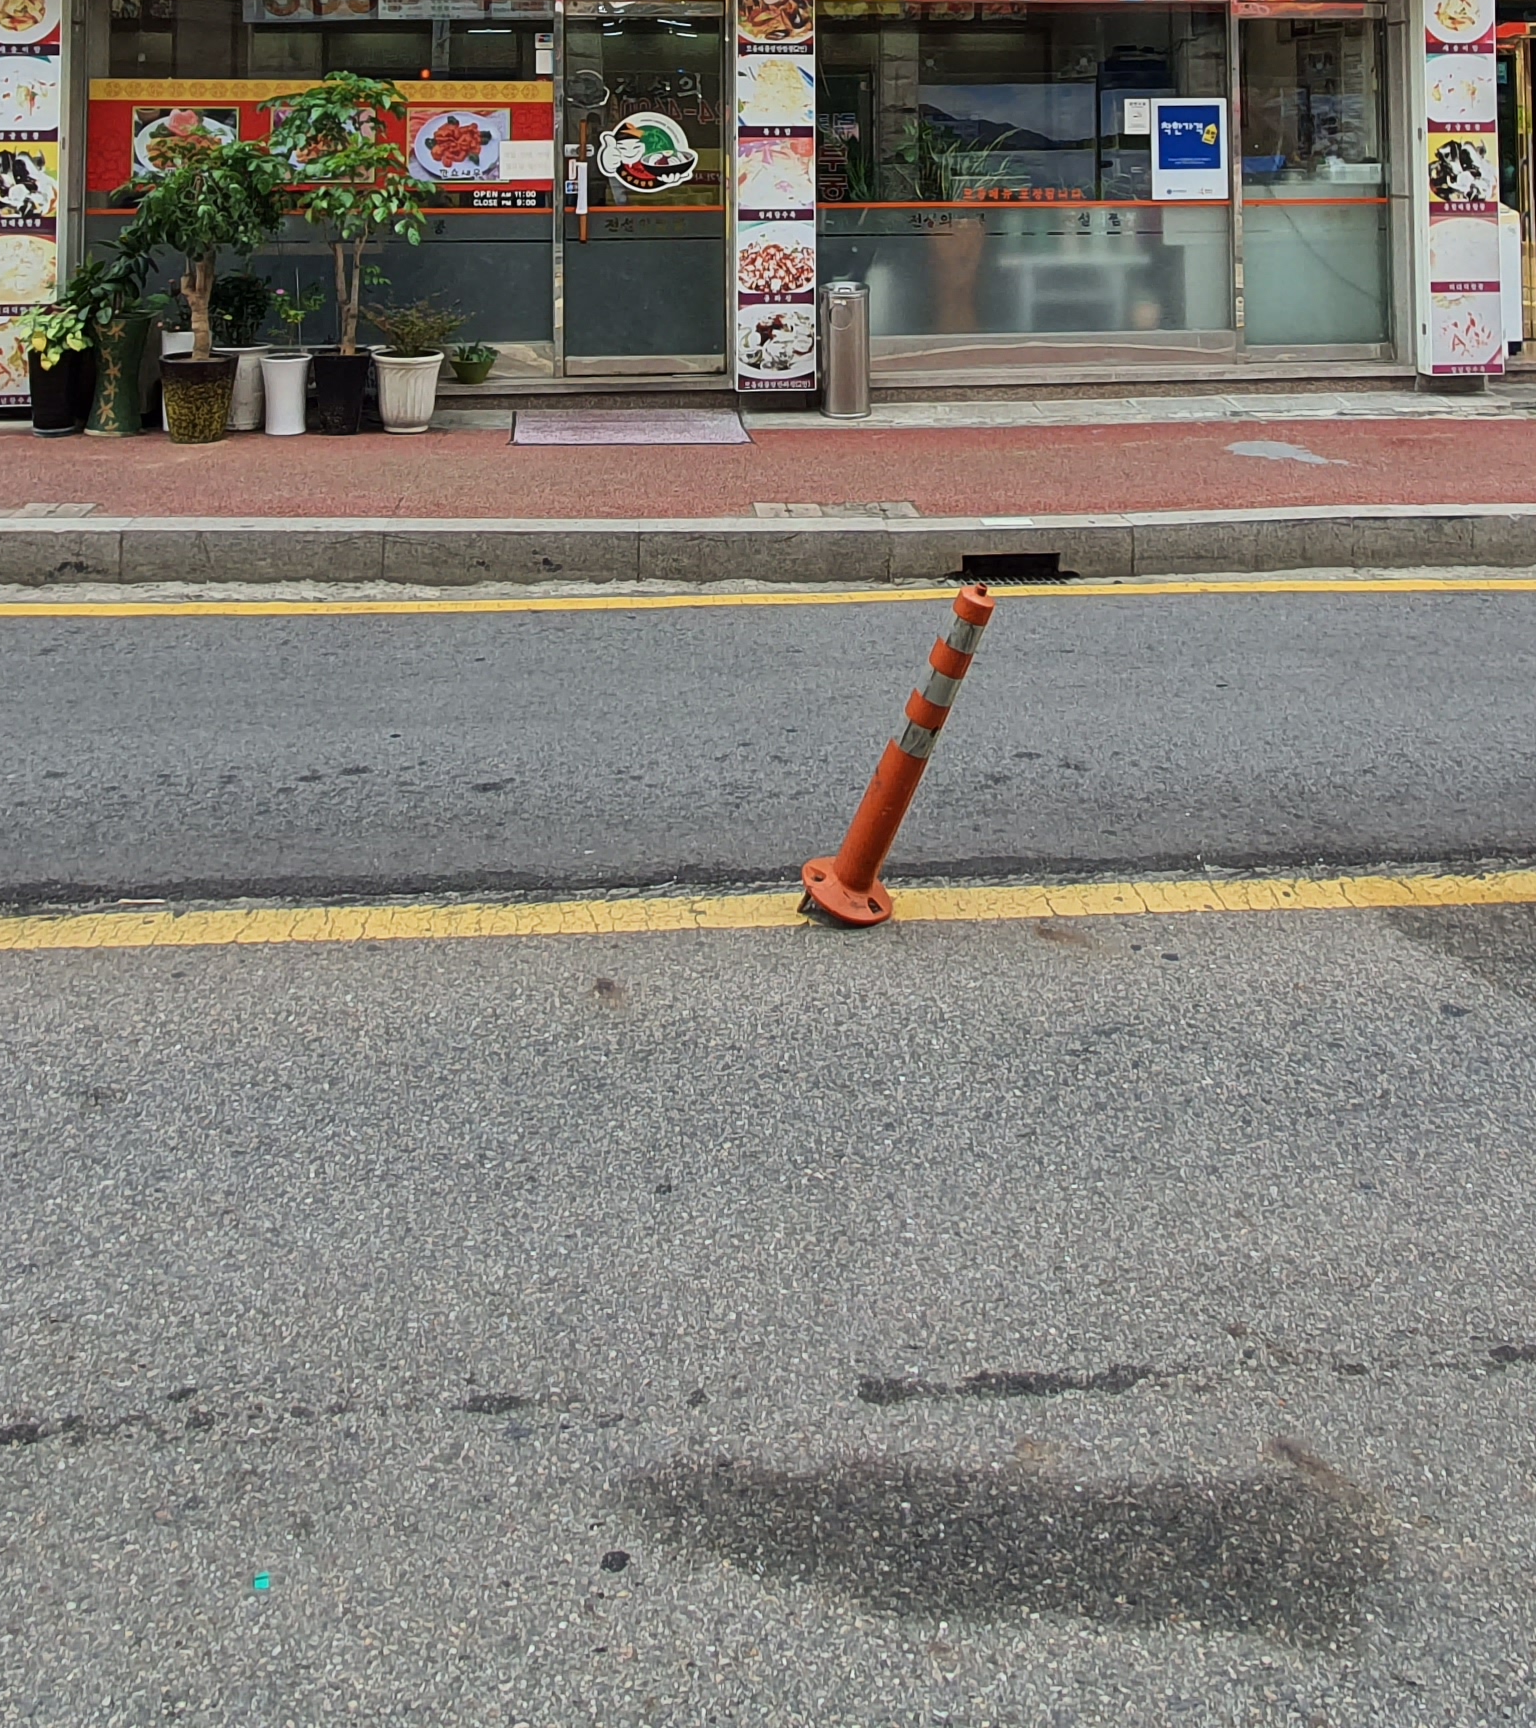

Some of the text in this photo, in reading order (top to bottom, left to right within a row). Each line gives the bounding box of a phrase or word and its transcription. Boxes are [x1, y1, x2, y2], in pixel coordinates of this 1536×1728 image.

[473, 190, 499, 198] OPEN
[514, 190, 537, 198] 11:00
[473, 199, 498, 207] CLOSE
[516, 199, 537, 207] 9:00
